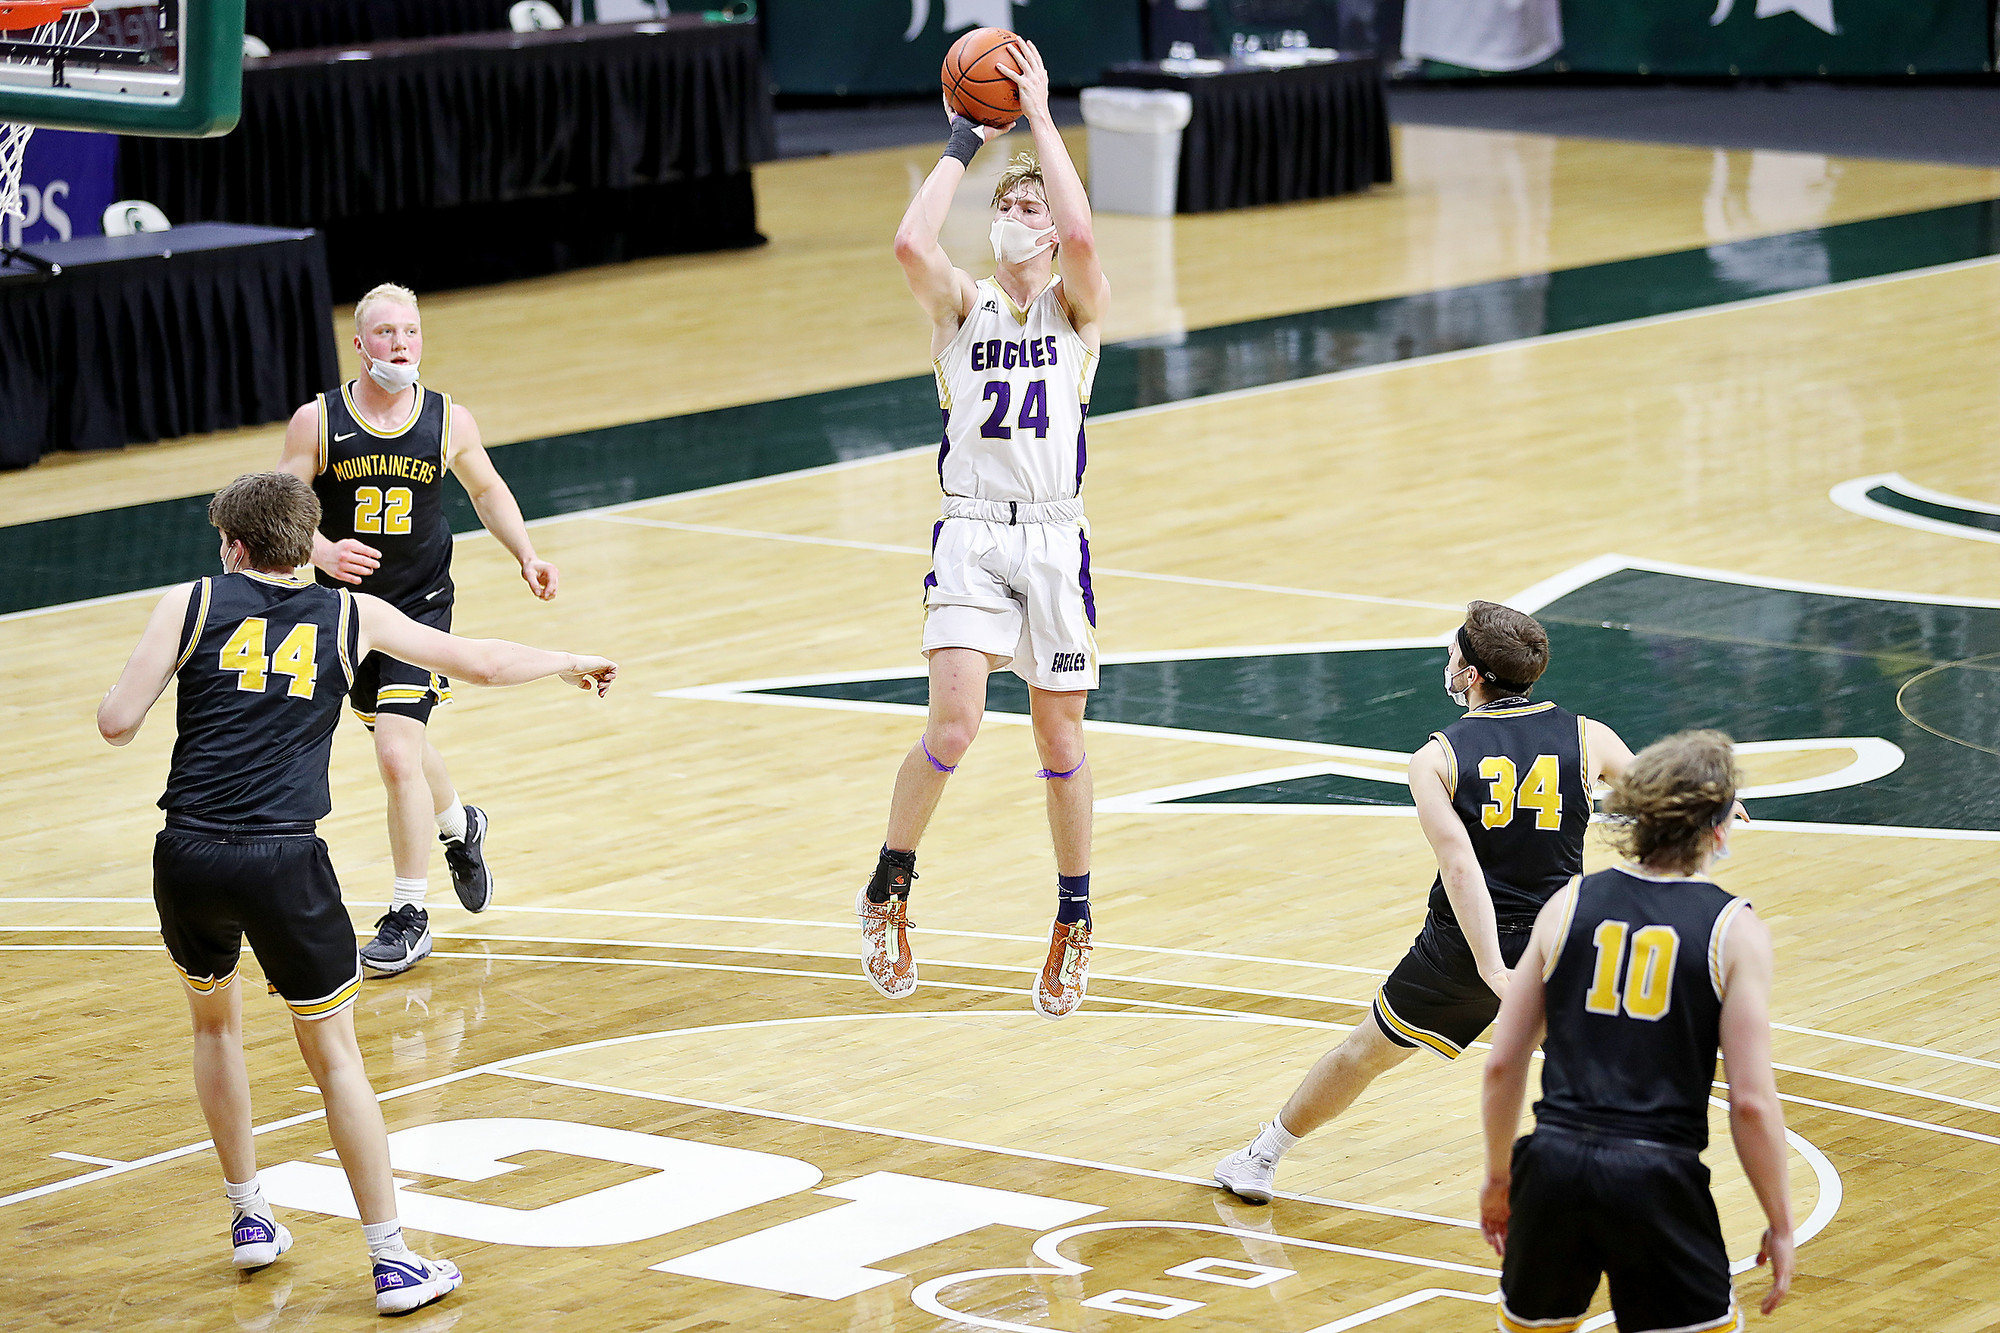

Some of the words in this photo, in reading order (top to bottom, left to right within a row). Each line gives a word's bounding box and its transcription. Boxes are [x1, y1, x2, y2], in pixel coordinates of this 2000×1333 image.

[0, 180, 72, 248] PS
[971, 335, 1058, 372] EAGLES
[980, 379, 1050, 440] 24
[333, 454, 437, 484] MOUNTAINEERS
[354, 486, 413, 534] 22
[219, 617, 318, 700] 44
[1051, 652, 1086, 673] EAGLES
[1478, 754, 1562, 831] 34
[1585, 919, 1680, 1022] 10
[375, 1272, 404, 1290] IKE
